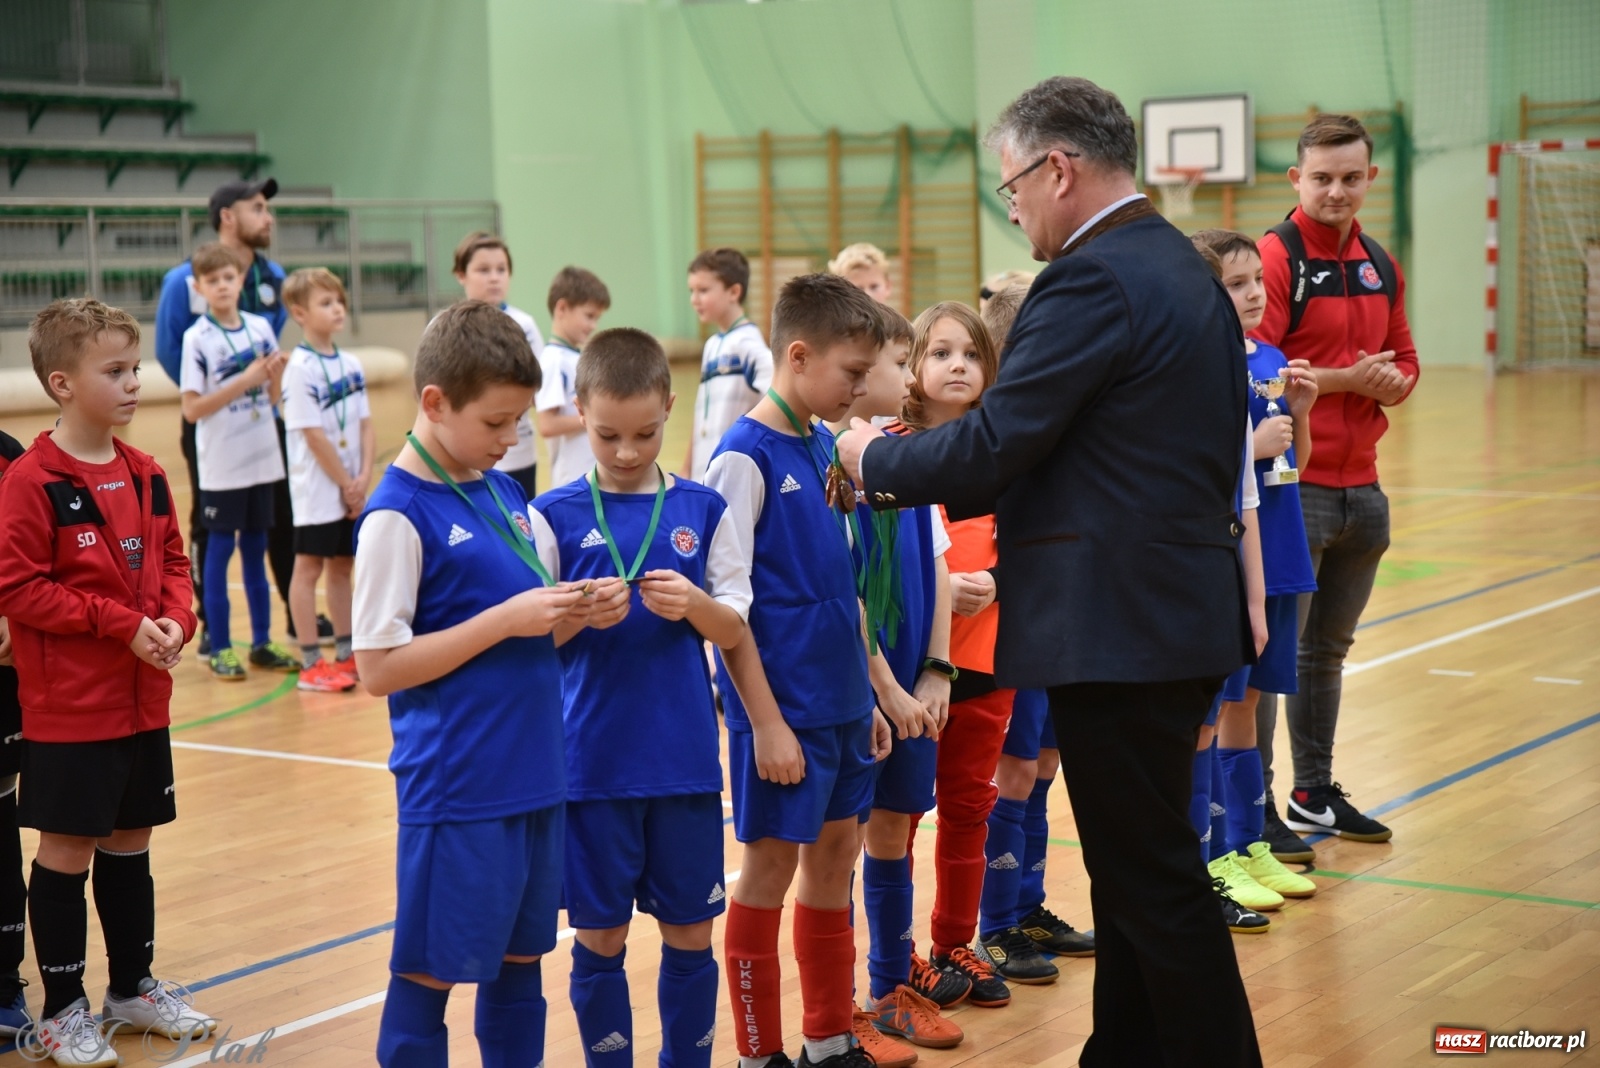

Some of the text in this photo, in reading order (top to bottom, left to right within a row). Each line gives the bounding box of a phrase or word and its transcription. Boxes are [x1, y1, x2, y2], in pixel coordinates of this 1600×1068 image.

[97, 480, 125, 491] regio
[780, 483, 802, 494] adidas
[77, 531, 97, 548] SD
[448, 531, 474, 547] adidas
[739, 960, 760, 1057] UKS CIESZY
[591, 1040, 629, 1053] adidas
